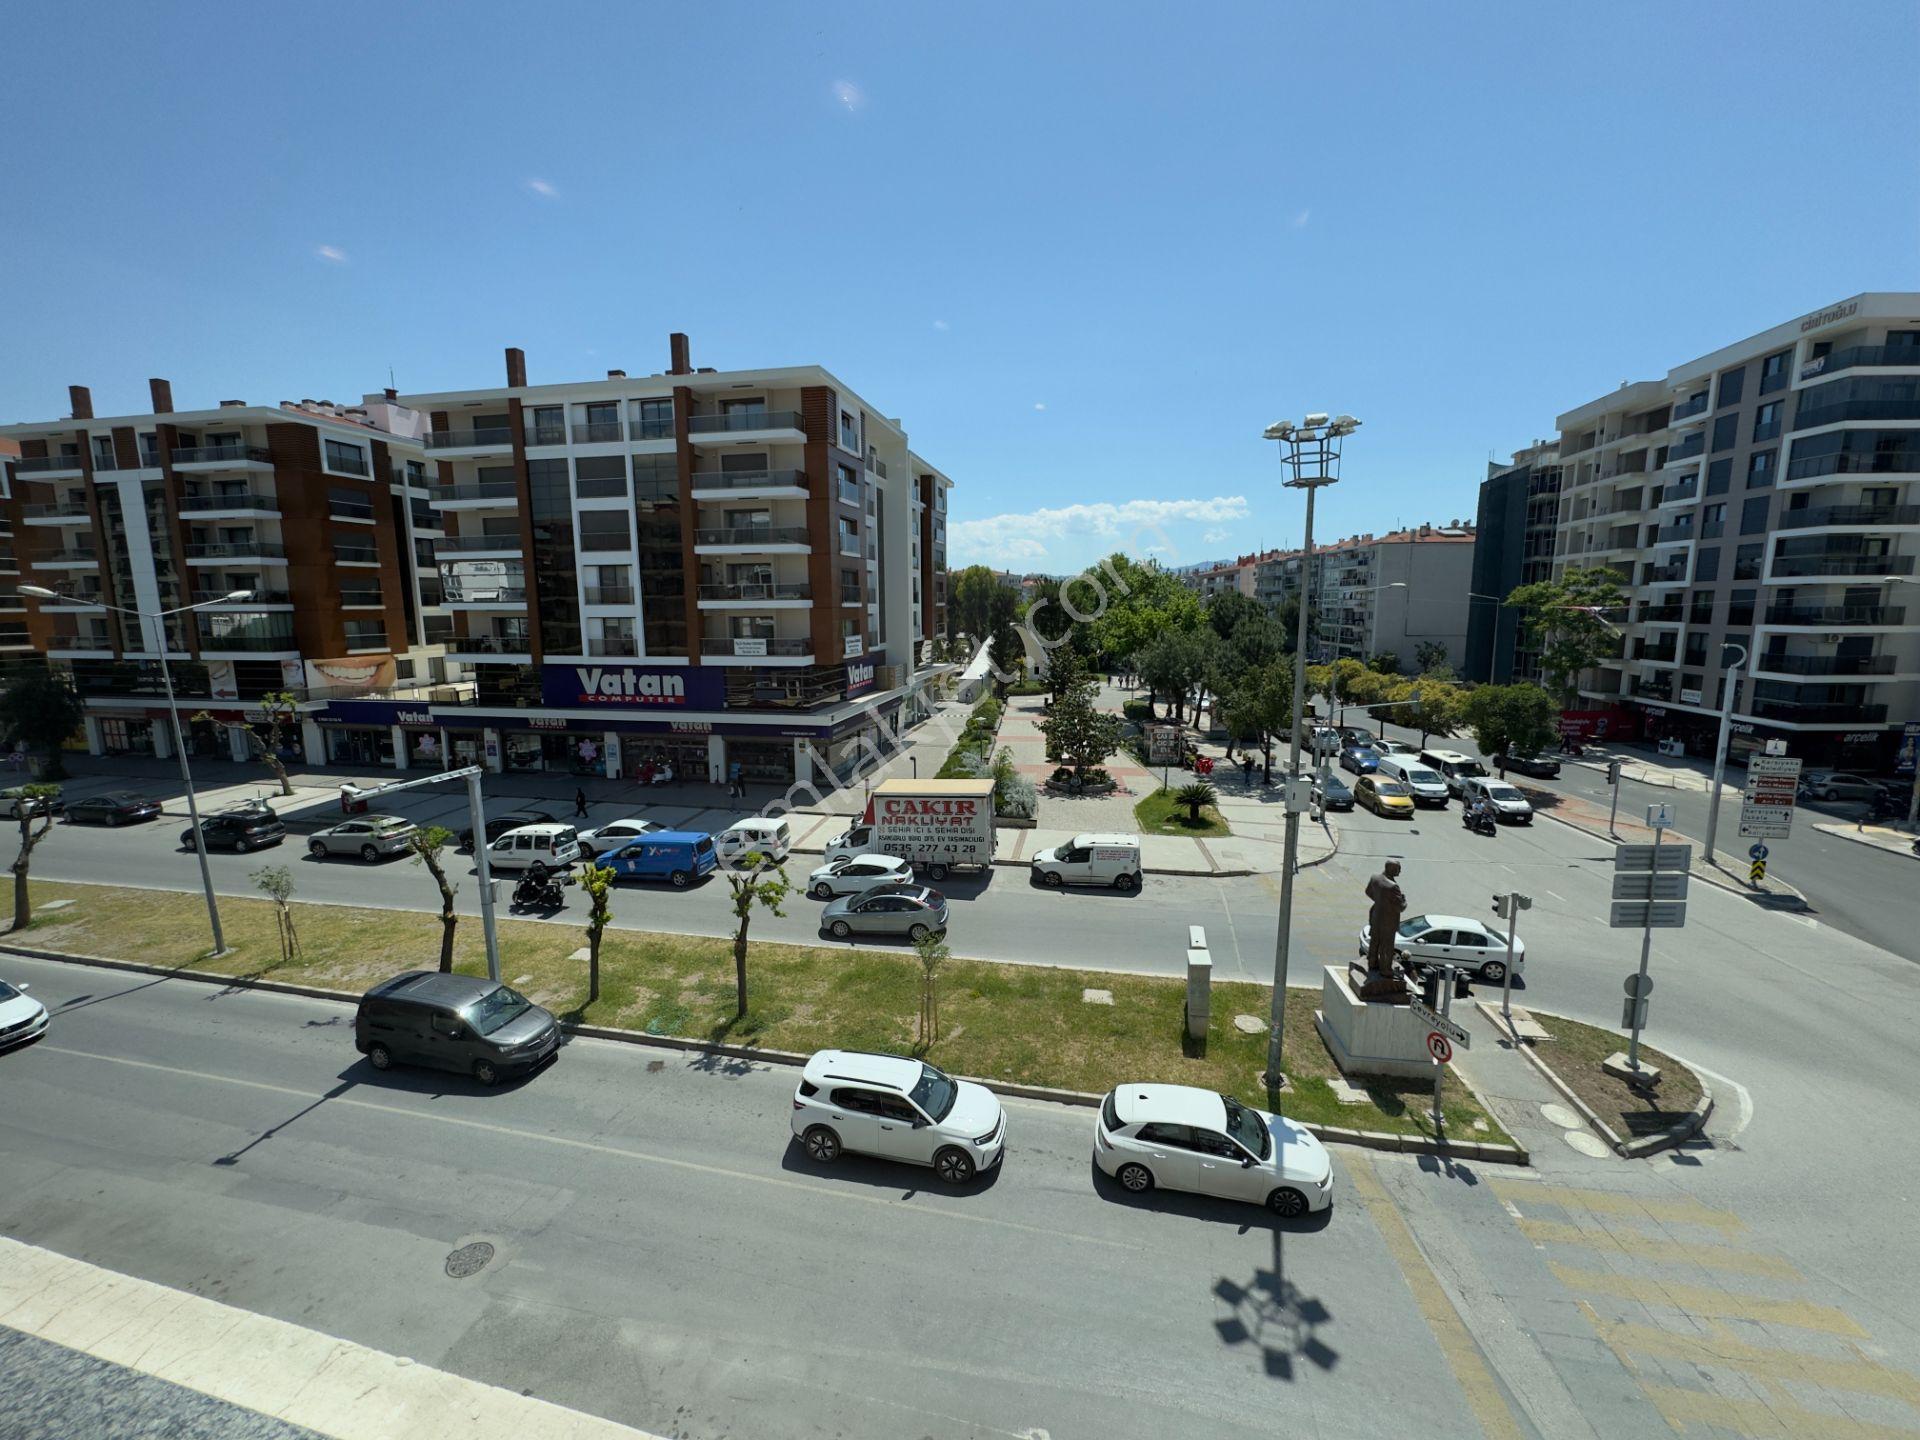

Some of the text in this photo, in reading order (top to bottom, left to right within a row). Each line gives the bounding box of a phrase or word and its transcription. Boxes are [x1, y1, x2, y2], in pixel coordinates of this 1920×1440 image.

[848, 663, 874, 684] Vatan
[576, 667, 685, 696] Vatan
[587, 695, 675, 703] COMPUTER
[397, 711, 433, 722] Vatan
[1844, 732, 1879, 744] arçelik
[885, 800, 978, 817] ÇAKIR
[881, 815, 974, 827] NAKLİYAT
[884, 843, 976, 853] 0535 277 43 28
[1412, 1000, 1456, 1036] Çevreyolu
